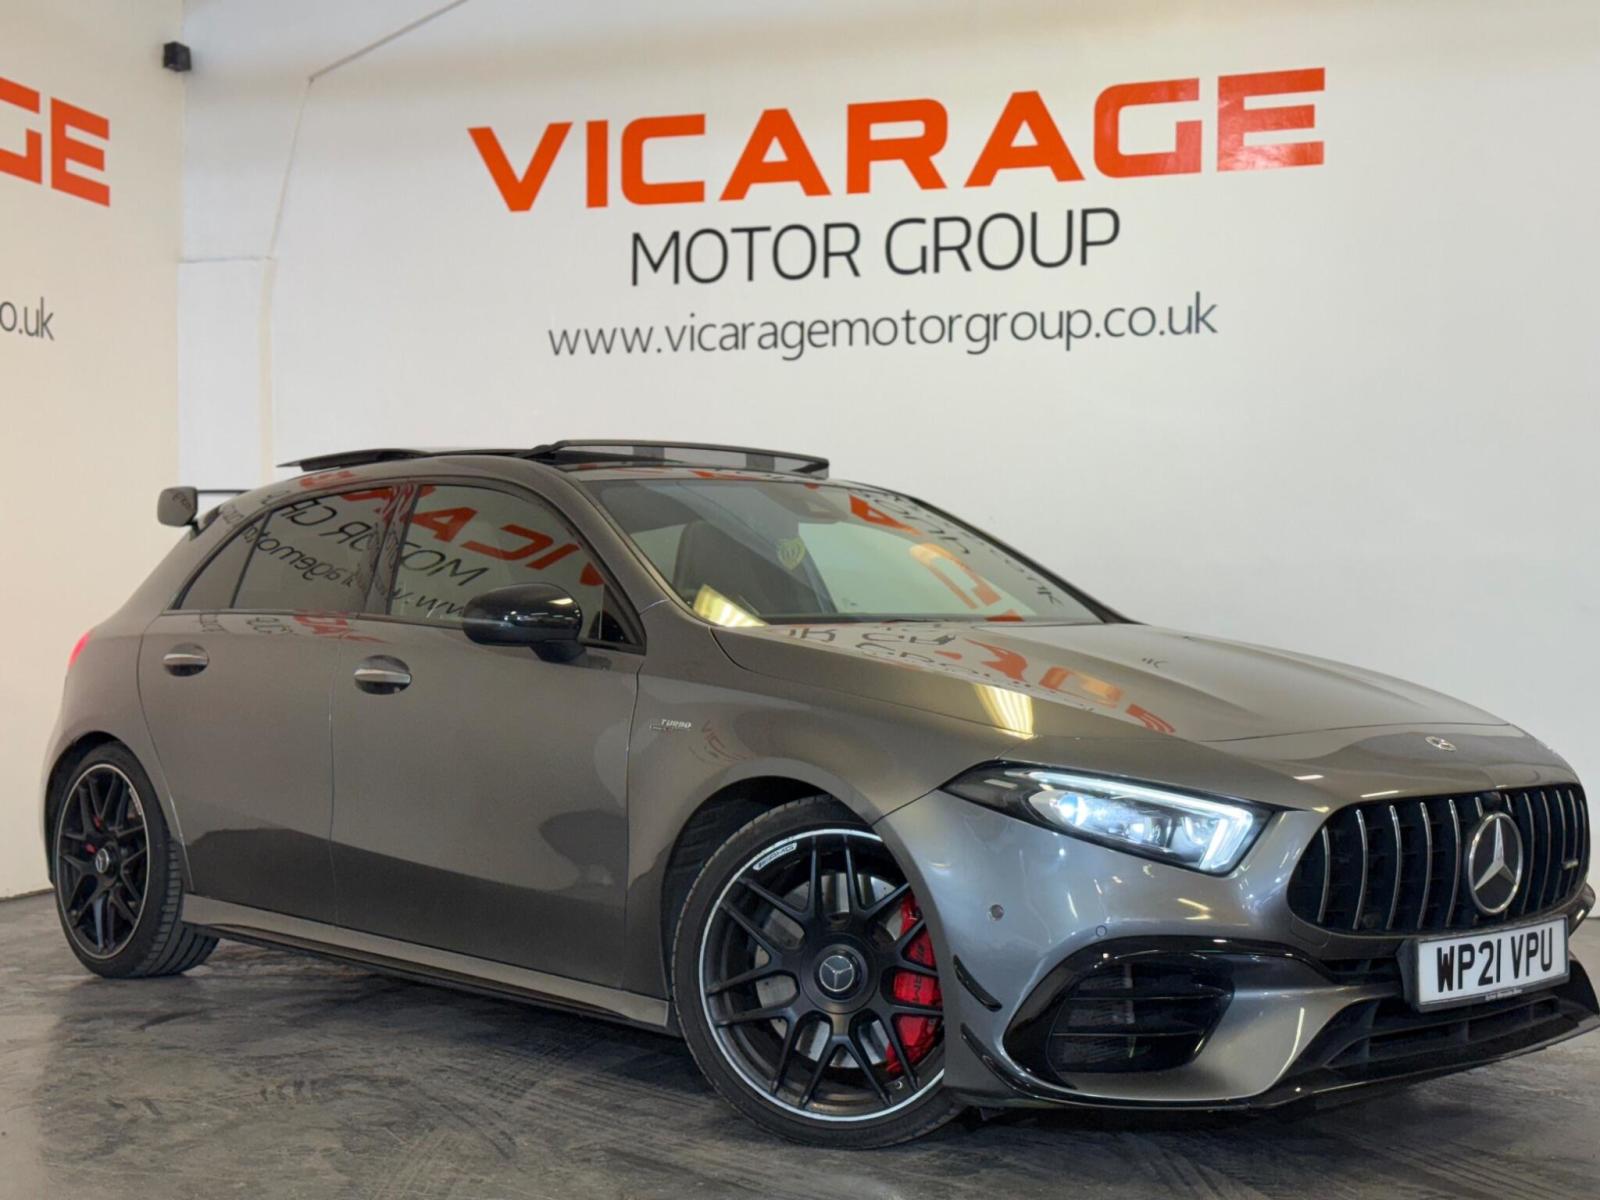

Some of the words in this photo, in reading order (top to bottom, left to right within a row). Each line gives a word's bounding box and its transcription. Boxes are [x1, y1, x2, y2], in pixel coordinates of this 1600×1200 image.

[469, 67, 1325, 213] VICARAGE
[631, 223, 860, 286] MOTOR
[885, 207, 1120, 275] GROUP
[548, 291, 1218, 361] www.vicaragemotorgroup.co.uk
[1436, 938, 1503, 993] WP21
[1510, 927, 1553, 979] VPU
